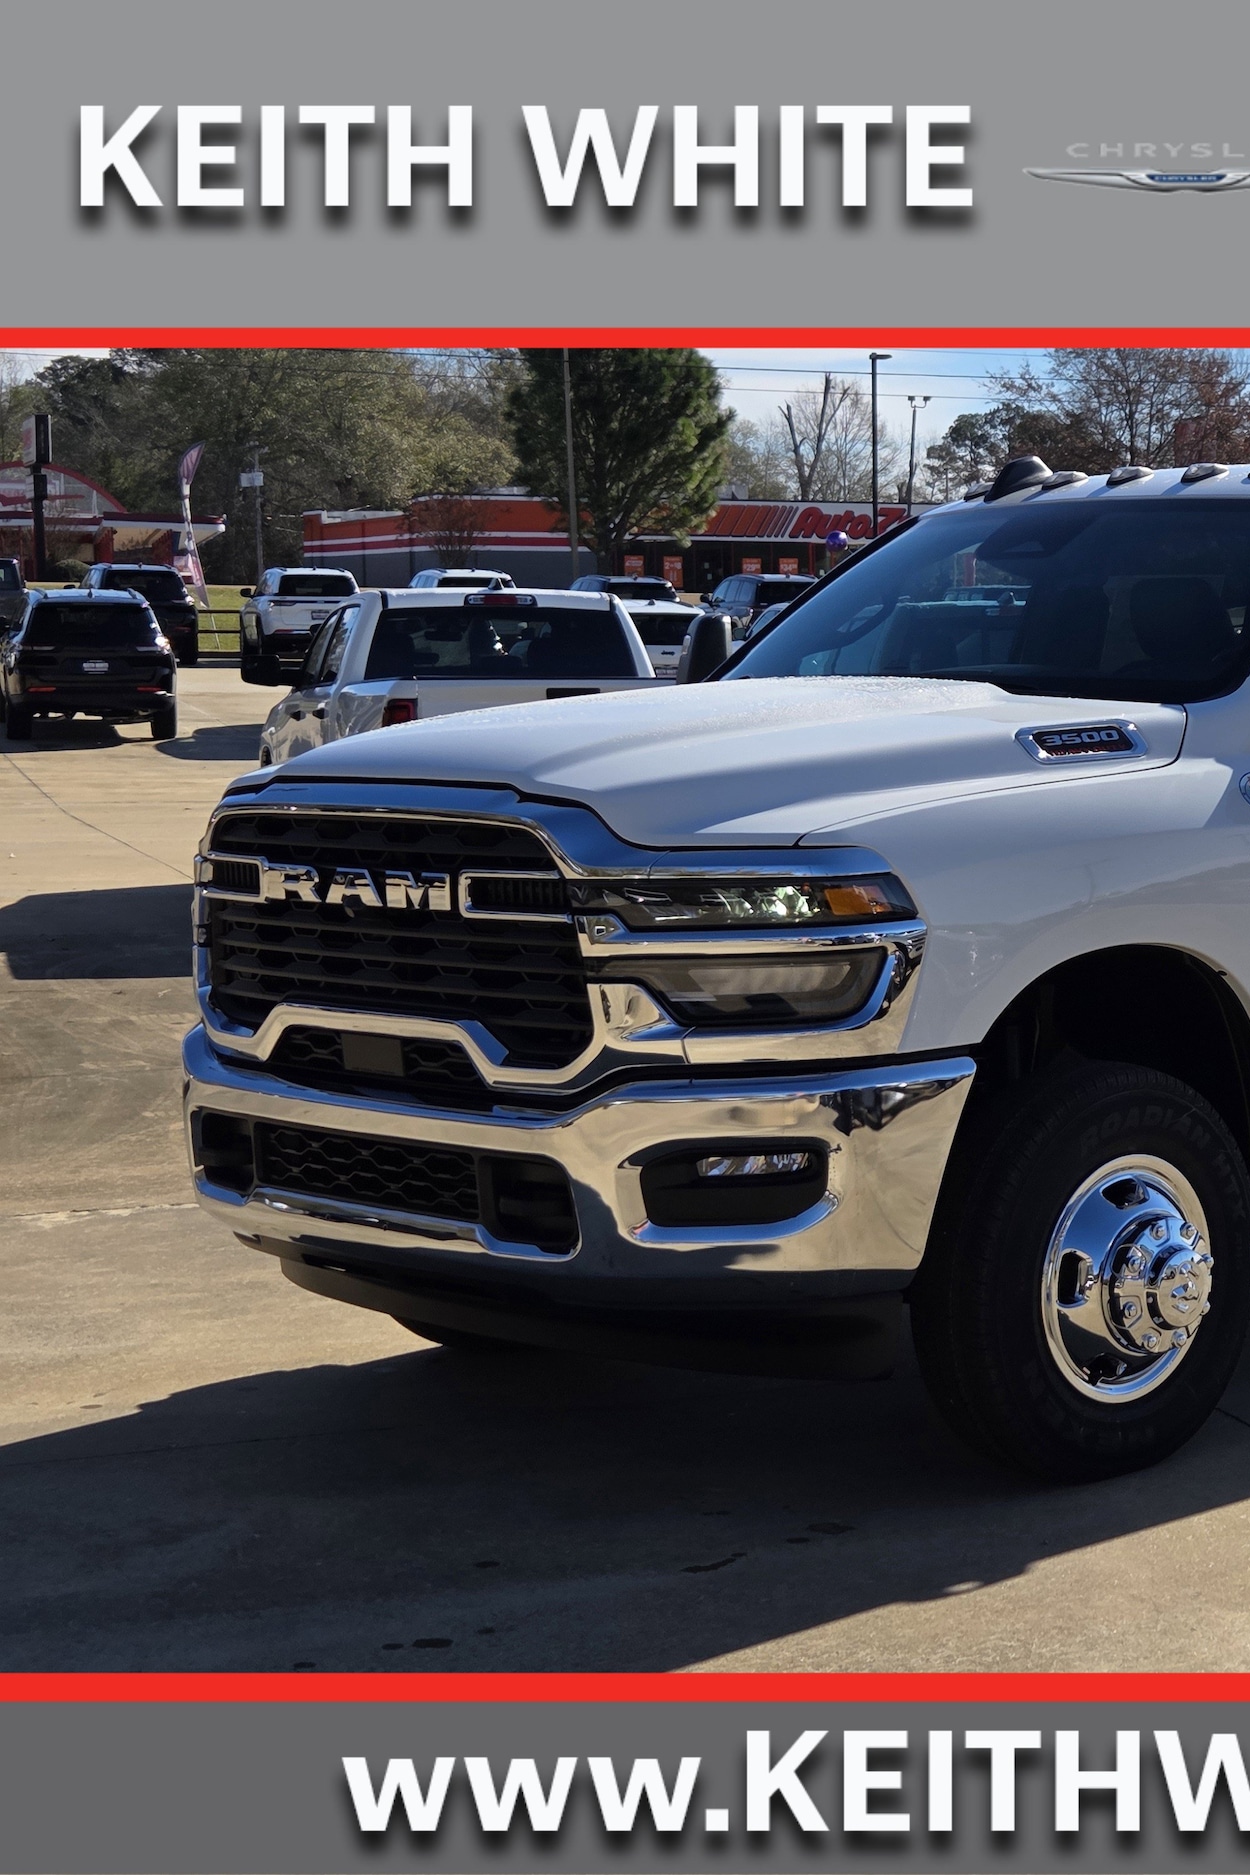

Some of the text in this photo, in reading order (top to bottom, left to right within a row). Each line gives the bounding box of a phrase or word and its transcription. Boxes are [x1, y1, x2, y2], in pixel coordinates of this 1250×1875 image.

[789, 507, 911, 540] AutoZ
[1042, 730, 1120, 746] 3500
[264, 862, 451, 911] RAM
[1079, 1104, 1212, 1158] ROADIAN
